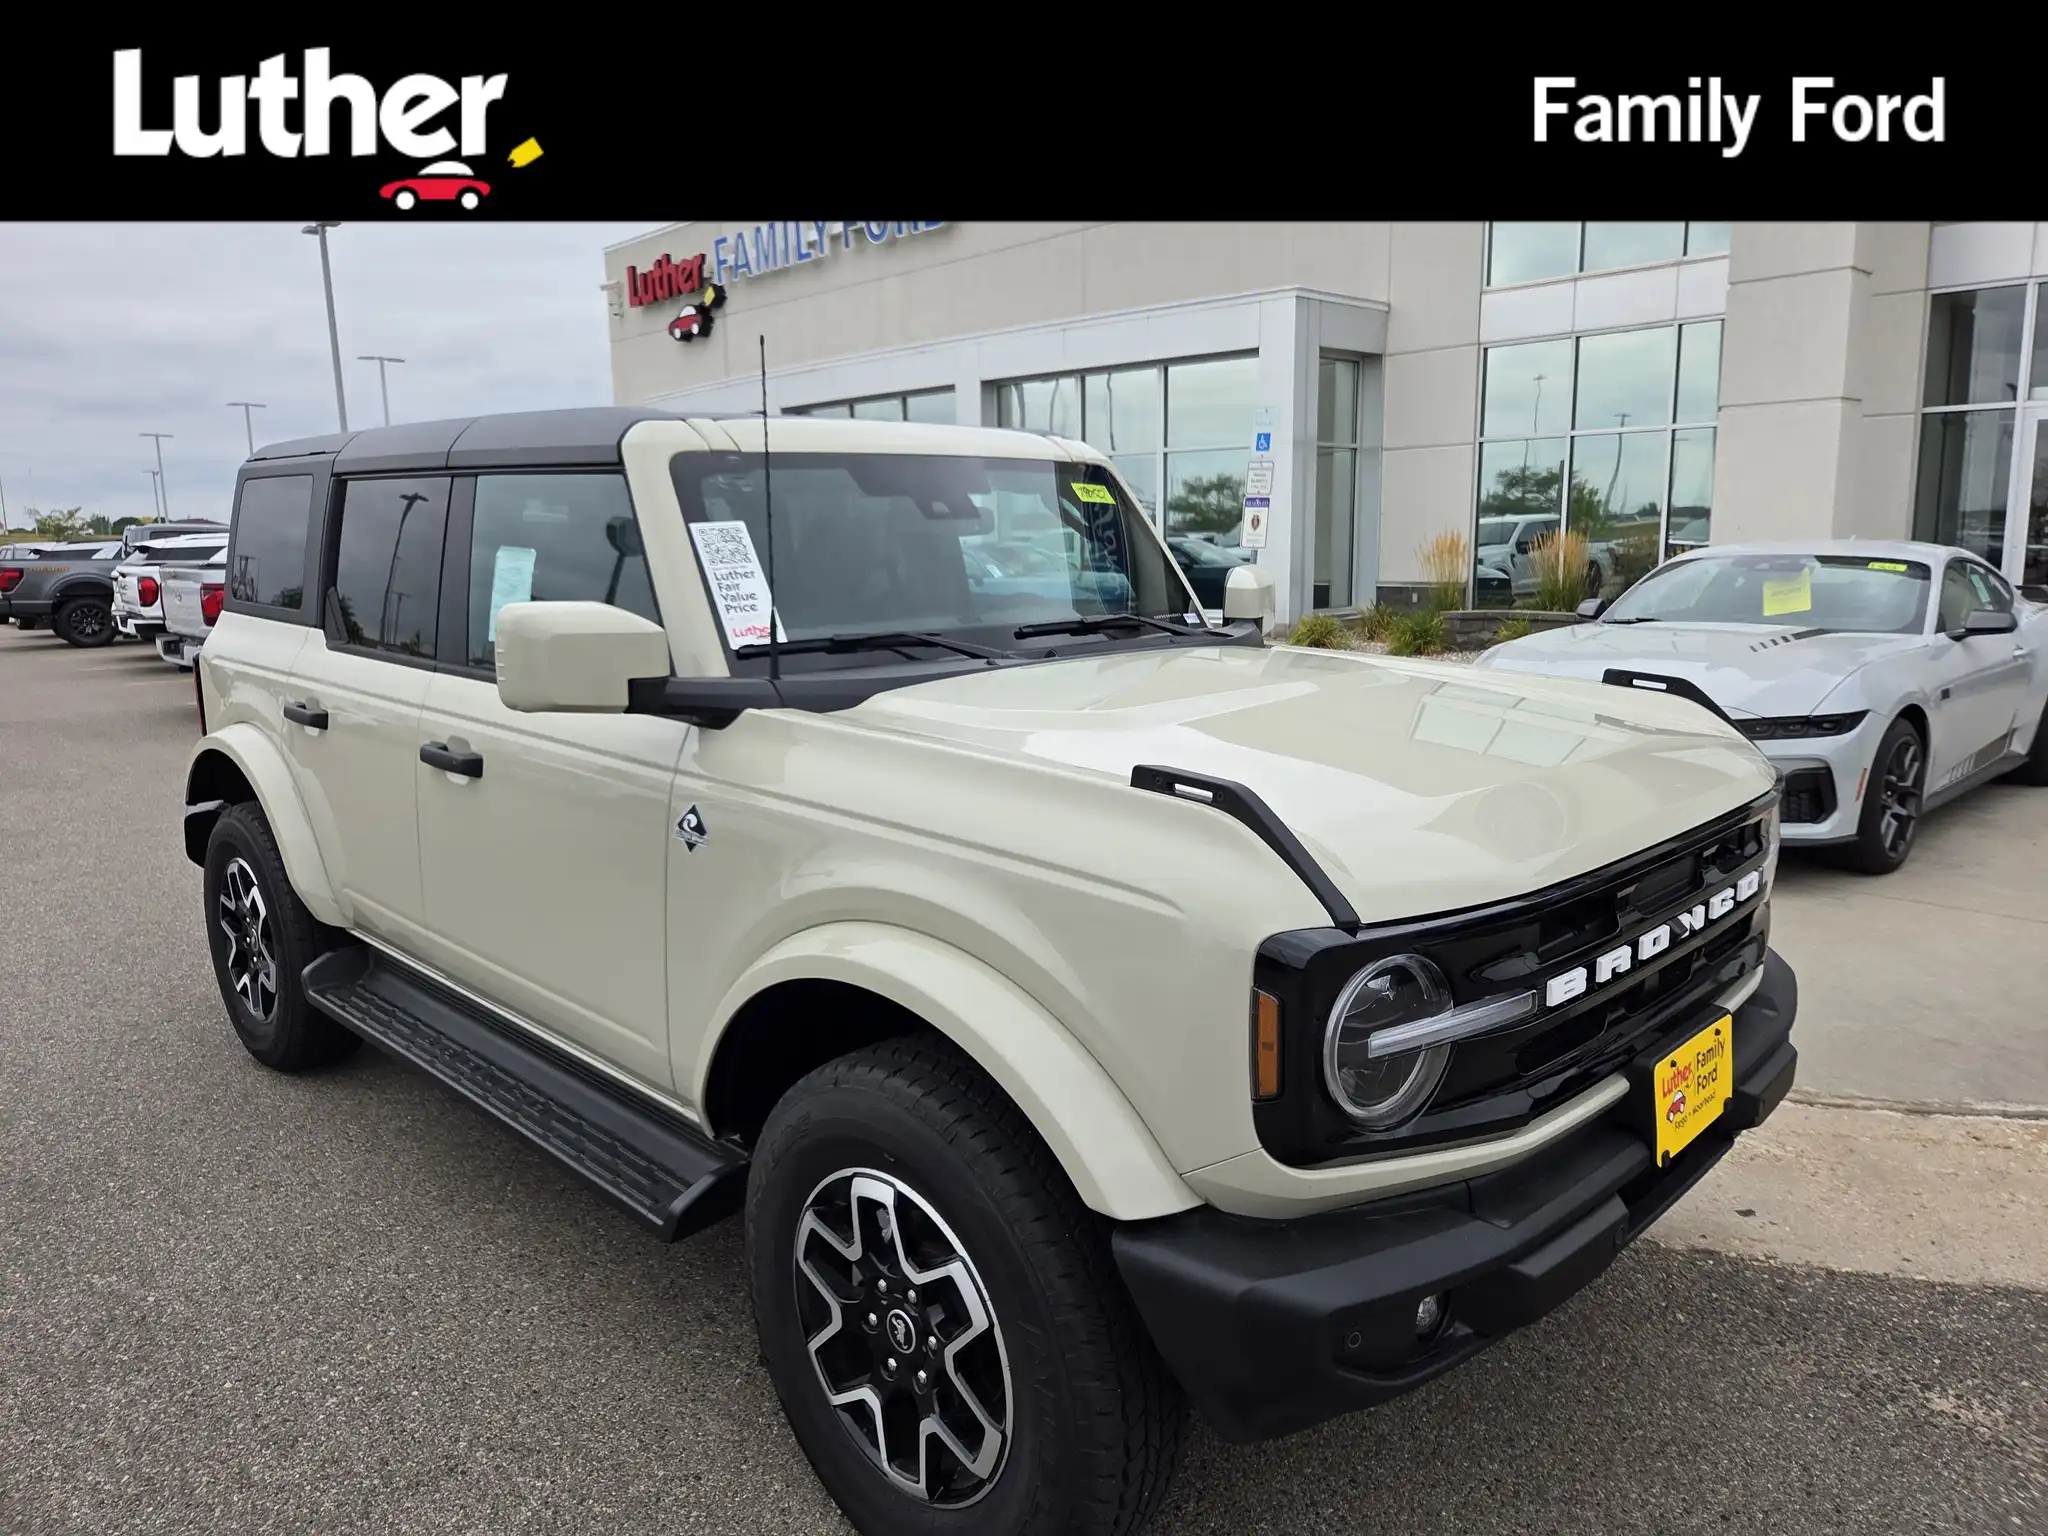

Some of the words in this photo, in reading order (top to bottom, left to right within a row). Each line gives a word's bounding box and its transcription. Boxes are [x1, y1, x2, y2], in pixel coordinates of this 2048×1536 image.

[713, 220, 828, 286] FAMILY
[626, 253, 707, 308] Luther
[713, 570, 756, 582] Luther
[717, 582, 741, 593] Fair
[720, 592, 758, 603] Value
[724, 603, 758, 615] Price
[732, 624, 771, 638] Luthe
[1546, 870, 1760, 1007] BRONCO
[1696, 1037, 1726, 1071] Family
[1662, 1063, 1692, 1098] Luther
[1696, 1062, 1718, 1095] Ford
